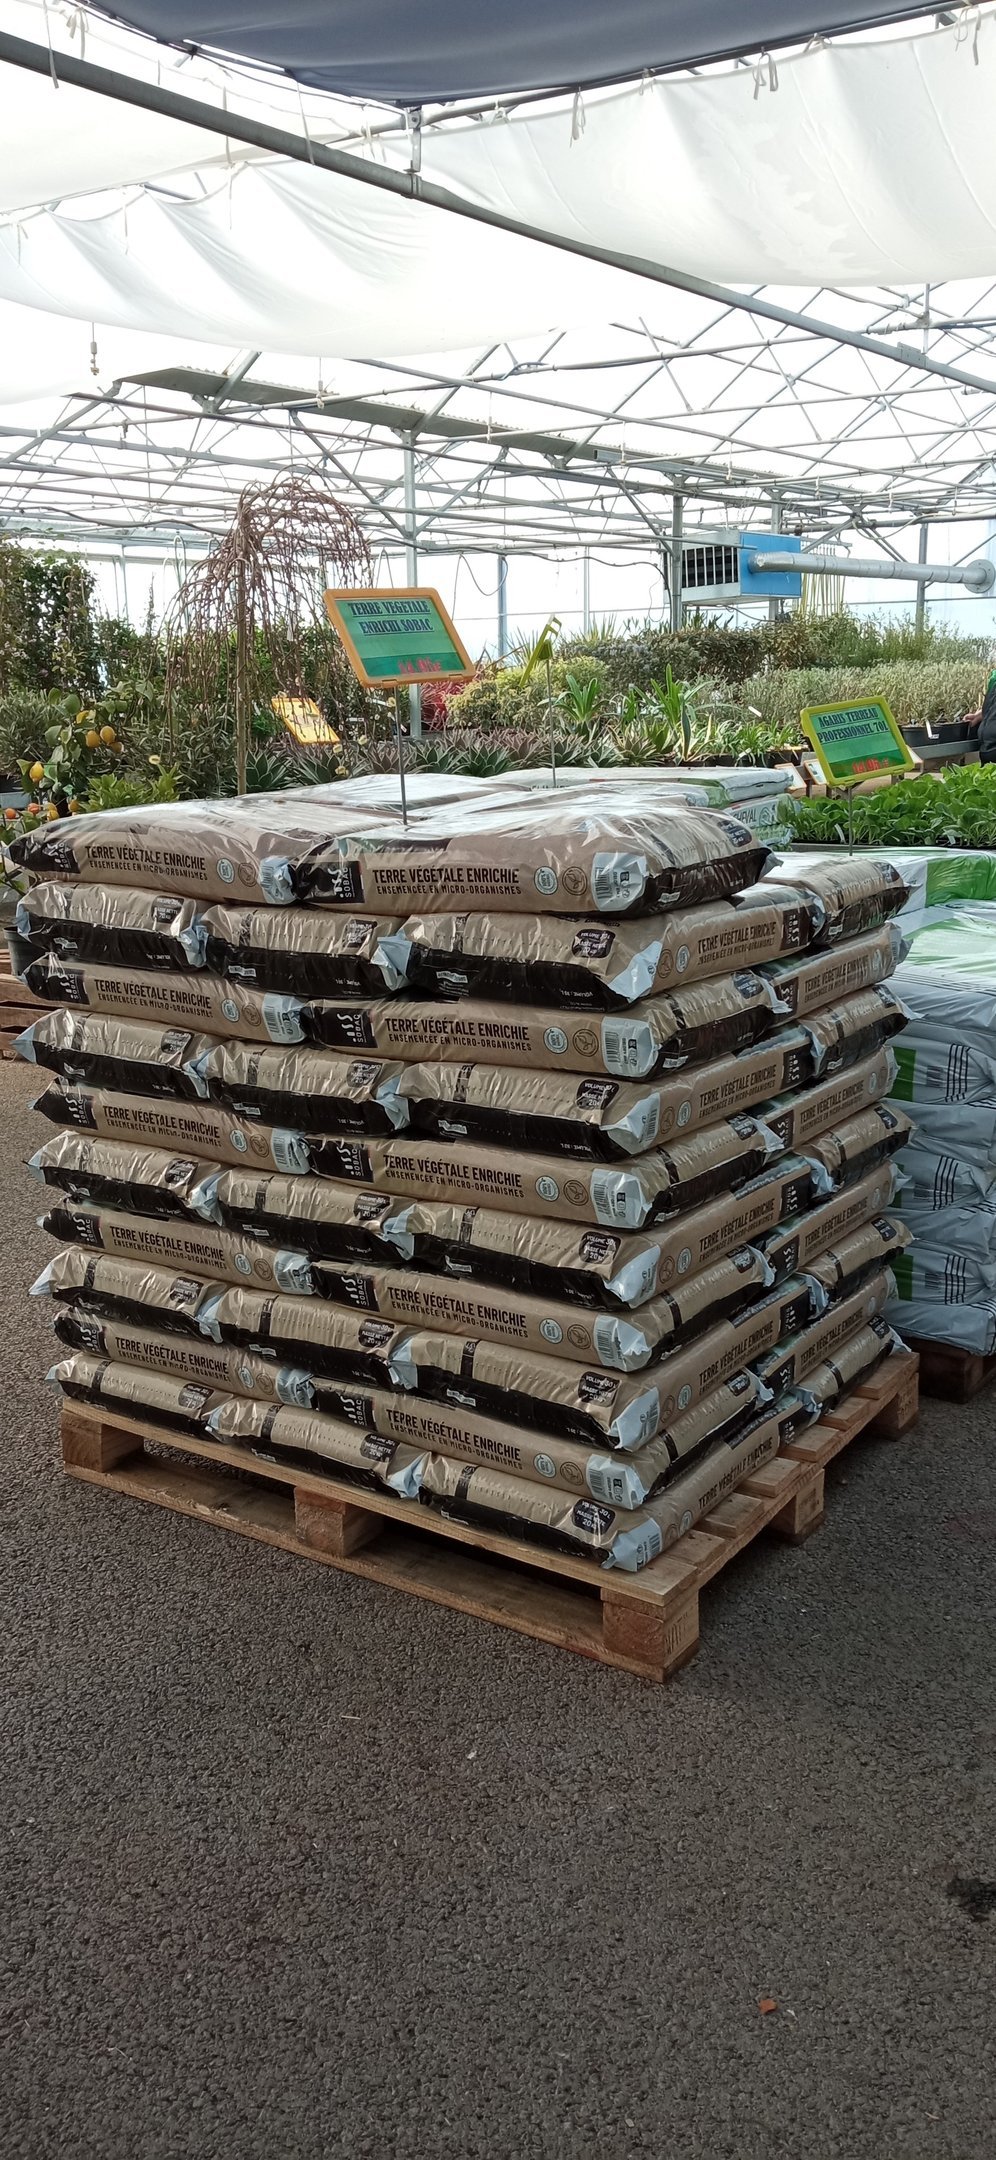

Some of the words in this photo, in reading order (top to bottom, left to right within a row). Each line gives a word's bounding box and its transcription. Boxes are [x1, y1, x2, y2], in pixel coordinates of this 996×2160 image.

[348, 601, 382, 615] TERRE
[383, 600, 430, 613] VEGETALE
[359, 619, 400, 634] ENRICHI
[400, 618, 433, 631] SOBAC
[818, 711, 846, 728] AGARIS
[846, 707, 878, 722] TERREAU
[817, 724, 874, 743] PROFESSIONNEL
[85, 845, 116, 859] TERRE
[116, 844, 161, 864] VÉGÉTALE
[163, 852, 206, 870] ENRICHIE
[133, 863, 141, 871] EN
[343, 867, 352, 898] SOBAC
[372, 869, 406, 884] TERRE
[408, 865, 464, 883] VÉGÉTALE
[467, 868, 520, 884] ENRICHIE
[429, 885, 439, 894] EN
[441, 884, 521, 895] MICRO-ORGANISMES
[698, 935, 718, 954] TERRE
[94, 979, 121, 993] TERRE
[123, 980, 168, 1000] VÉGÉTALE
[170, 989, 212, 1009] ENRICHIE
[353, 1014, 364, 1043] SOBAC
[385, 1018, 419, 1032] TERRE
[421, 1016, 476, 1036] VÉGÉTALE
[478, 1023, 530, 1041] ENRICHIE
[440, 1036, 450, 1045] EN
[453, 1036, 532, 1051] MICRO-ORGANISMES
[700, 1088, 720, 1107] TERRE
[720, 1075, 749, 1098] VÉGÉTALE
[750, 1064, 777, 1087] ENRICHIE
[103, 1105, 131, 1121] TERRE
[131, 1108, 177, 1128] VÉGÉTALE
[178, 1119, 220, 1138] ENRICHIE
[351, 1148, 361, 1176] SOBAC
[383, 1154, 415, 1171] TERRE
[417, 1156, 469, 1179] VÉGÉTALE
[471, 1167, 522, 1188] ENRICHIE
[436, 1177, 446, 1185] EN
[449, 1178, 525, 1198] MICRO-ORGANISMES
[700, 1230, 719, 1251] TERRE
[720, 1213, 749, 1241] VÉGÉTALE
[749, 1198, 775, 1223] ENRICHIE
[109, 1225, 138, 1241] TERRE
[138, 1230, 182, 1250] VÉGÉTALE
[184, 1241, 225, 1261] ENRICHIE
[356, 1279, 367, 1306] SOBAC
[387, 1286, 421, 1304] TERRE
[423, 1291, 475, 1316] VÉGÉTALE
[477, 1305, 527, 1328] ENRICHIE
[442, 1311, 451, 1319] EN
[453, 1313, 529, 1338] MICRO-ORGANISMES
[115, 1336, 142, 1353] TERRE
[143, 1342, 188, 1363] VÉGÉTALE
[188, 1354, 229, 1375] ENRICHIE
[700, 1361, 719, 1384] TERRE
[719, 1339, 748, 1369] VÉGÉTALE
[748, 1320, 774, 1348] ENRICHIE
[356, 1399, 365, 1426] SOBAC
[386, 1409, 418, 1429] TERRE
[420, 1417, 471, 1445] VÉGÉTALE
[473, 1434, 522, 1461] ENRICHIE
[438, 1437, 448, 1445] EN
[450, 1440, 523, 1470] MICRO-ORGANISMES
[698, 1485, 718, 1511] TERRE
[576, 1510, 593, 1520] MASSE
[582, 1518, 591, 1527] 20
[599, 1508, 608, 1517] 30
